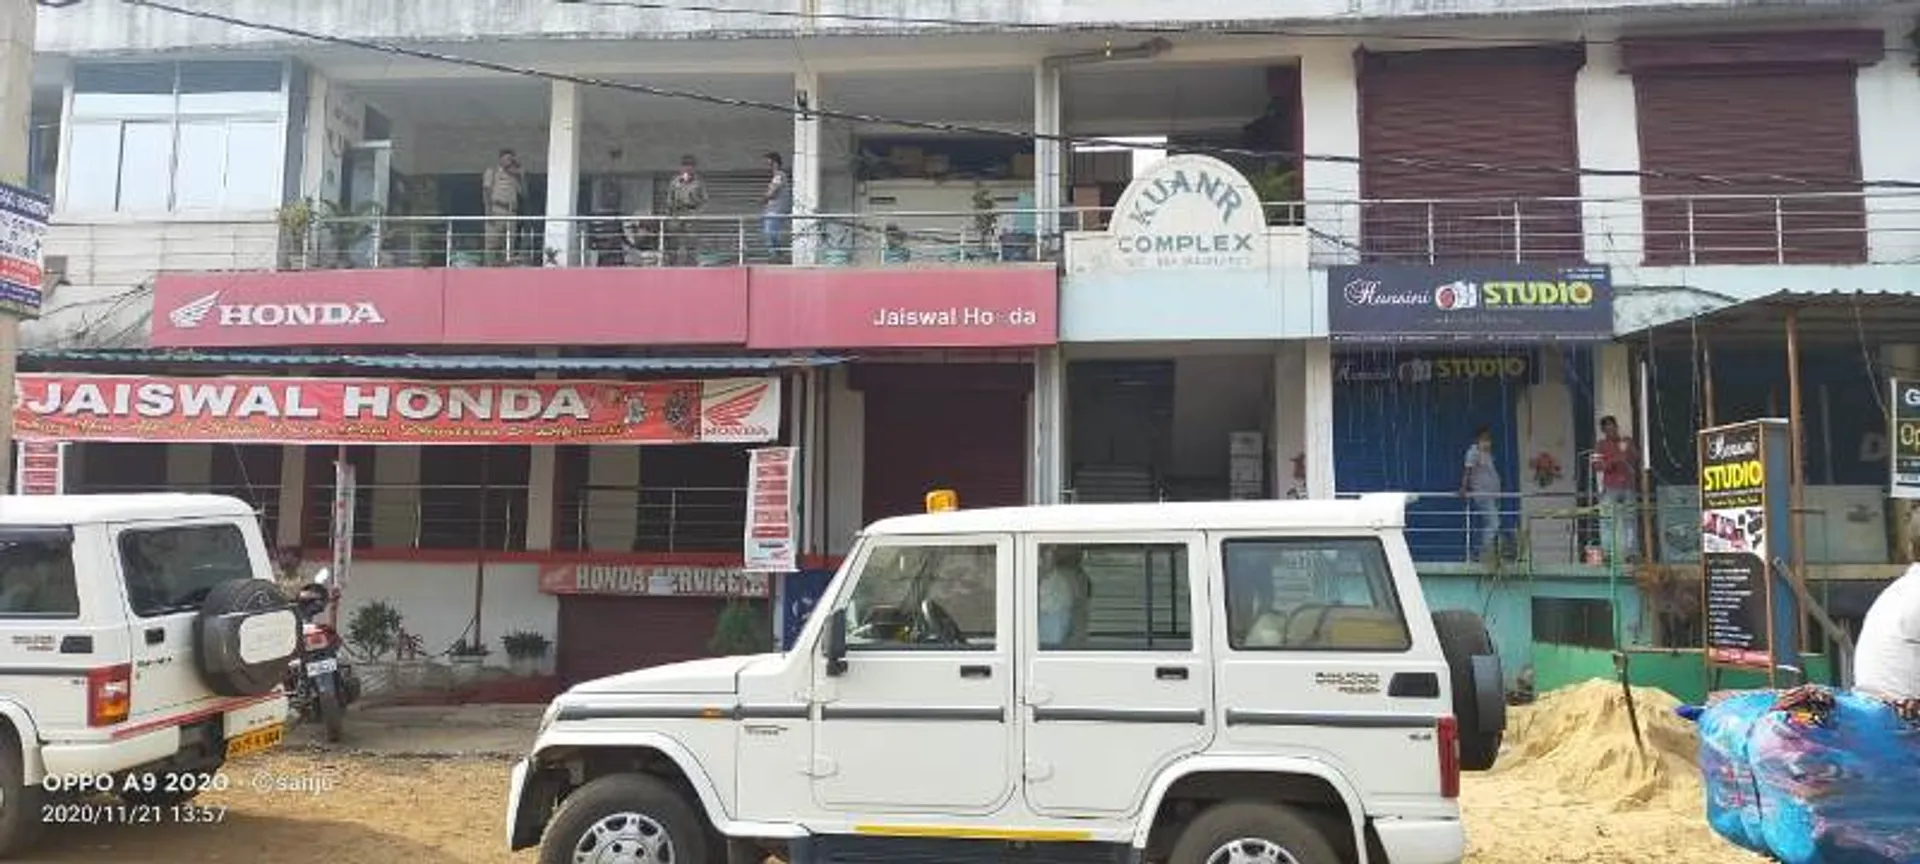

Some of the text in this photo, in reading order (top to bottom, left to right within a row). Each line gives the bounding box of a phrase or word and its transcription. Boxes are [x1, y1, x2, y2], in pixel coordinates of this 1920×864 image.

[1130, 170, 1242, 226] KUANR
[1118, 233, 1253, 253] COMPLEX
[1482, 281, 1593, 306] STUDIO
[219, 302, 385, 326] HONDA
[872, 307, 1037, 327] Jaiswal Hoda
[27, 383, 590, 420] JAISWAL HONDA
[704, 426, 769, 437] HONDA
[1703, 460, 1763, 491] STUDIO
[576, 563, 646, 594] HONDA
